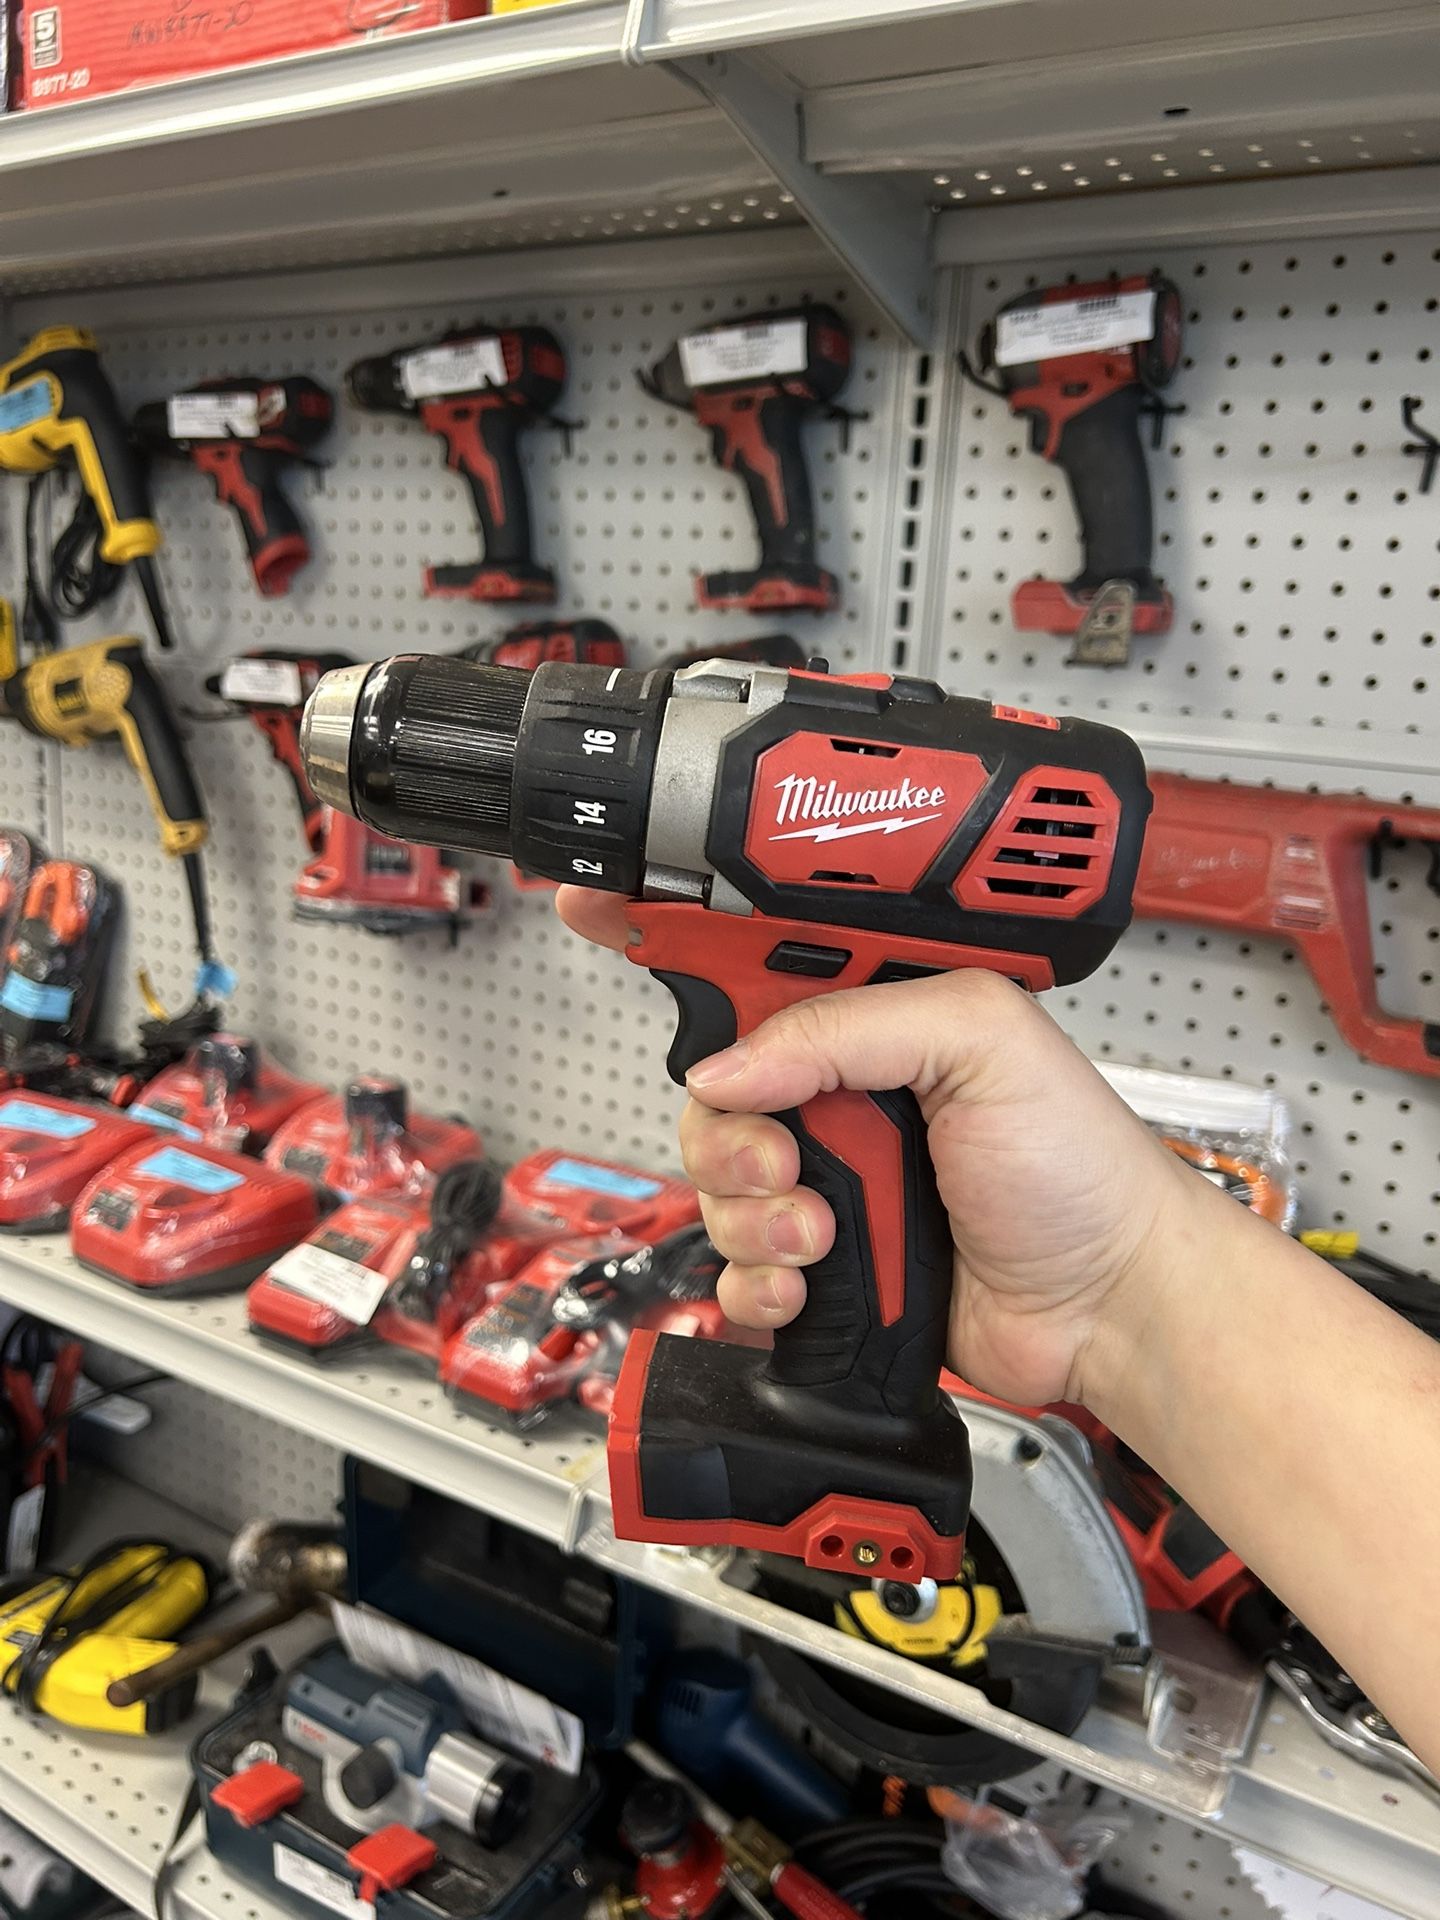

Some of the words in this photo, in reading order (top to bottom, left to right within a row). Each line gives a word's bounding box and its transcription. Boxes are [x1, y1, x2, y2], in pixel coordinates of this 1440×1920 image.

[36, 12, 55, 41] 5
[581, 728, 617, 755] 16
[573, 800, 607, 825] 14
[773, 773, 946, 826] Milwaukee
[572, 858, 603, 876] 12
